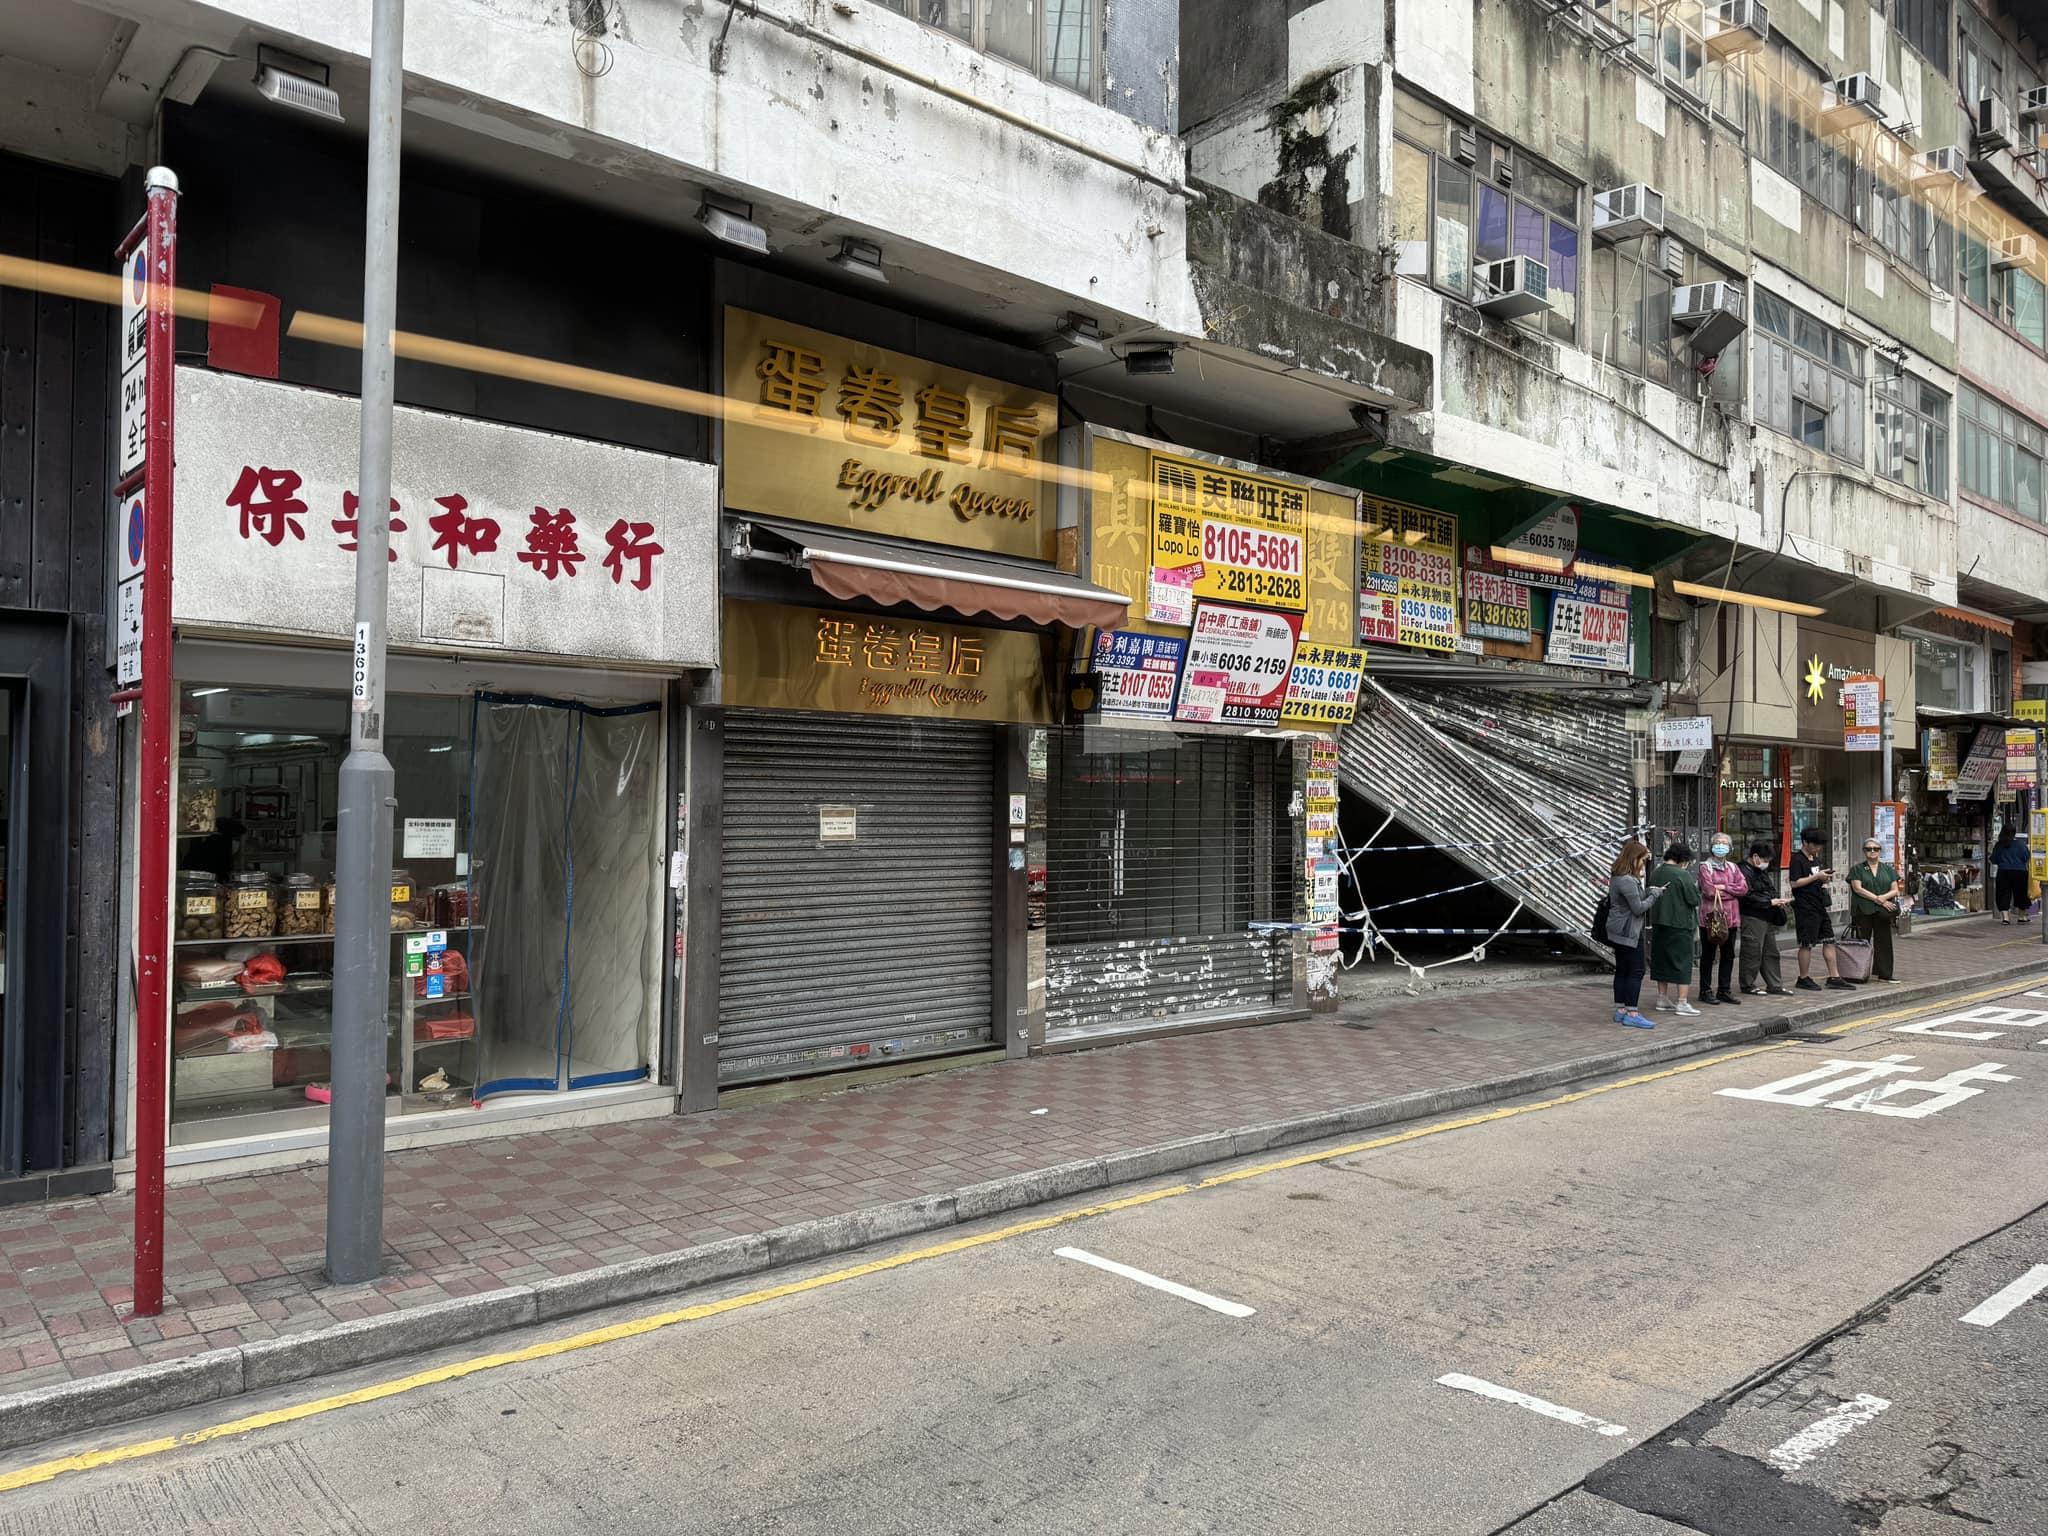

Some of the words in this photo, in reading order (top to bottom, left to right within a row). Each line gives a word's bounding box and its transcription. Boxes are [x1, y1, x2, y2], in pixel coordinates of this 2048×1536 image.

[125, 378, 137, 412] 24
[755, 338, 1040, 475] 蛋卷皇后
[838, 458, 944, 510] Eggroll
[951, 482, 1036, 521] Queen
[1202, 475, 1303, 525] 美聯旺舖
[1158, 512, 1200, 540] 羅寶怡
[1382, 504, 1453, 547] 美聯旺舖
[1157, 535, 1183, 556] Lopo
[1186, 539, 1199, 557] Lo
[1204, 524, 1299, 573] 8105-5681
[1529, 533, 1555, 548] 6035
[1557, 537, 1575, 553] 7986
[1383, 545, 1452, 571] 8100-3334
[1228, 570, 1301, 600] 2813-2628
[1383, 561, 1452, 586] 8208-0313
[1410, 584, 1452, 604] 永昇物業
[1469, 574, 1528, 609] 特約租售
[1401, 599, 1426, 617] 9363
[1429, 605, 1453, 623] 6681
[1555, 603, 1581, 633] 王先生
[1411, 618, 1423, 628] For
[1424, 620, 1445, 632] Lease
[1583, 606, 1605, 642] 8228
[1606, 609, 1627, 644] 3857
[119, 639, 138, 656] midnight
[815, 617, 985, 678] 蛋卷皇后
[1113, 636, 1155, 657] 利嘉閣
[1400, 629, 1454, 649] 27811682
[354, 628, 367, 697] 13606
[1115, 655, 1136, 666] 3392
[1218, 653, 1252, 672] 6036
[1253, 657, 1286, 675] 2159
[1308, 647, 1363, 669] 永昇物業
[1120, 671, 1147, 697] 8107
[1147, 674, 1173, 699] 0553
[1291, 666, 1324, 686] 9363
[1327, 671, 1359, 690] 6681
[859, 677, 927, 707] Eggroll
[929, 683, 987, 708] Queen
[1301, 687, 1310, 699] For
[1311, 689, 1328, 701] Lease
[1332, 691, 1345, 702] Sale
[1225, 704, 1251, 719] 2810
[1254, 708, 1279, 720] 9900
[1283, 701, 1353, 720] 27811682
